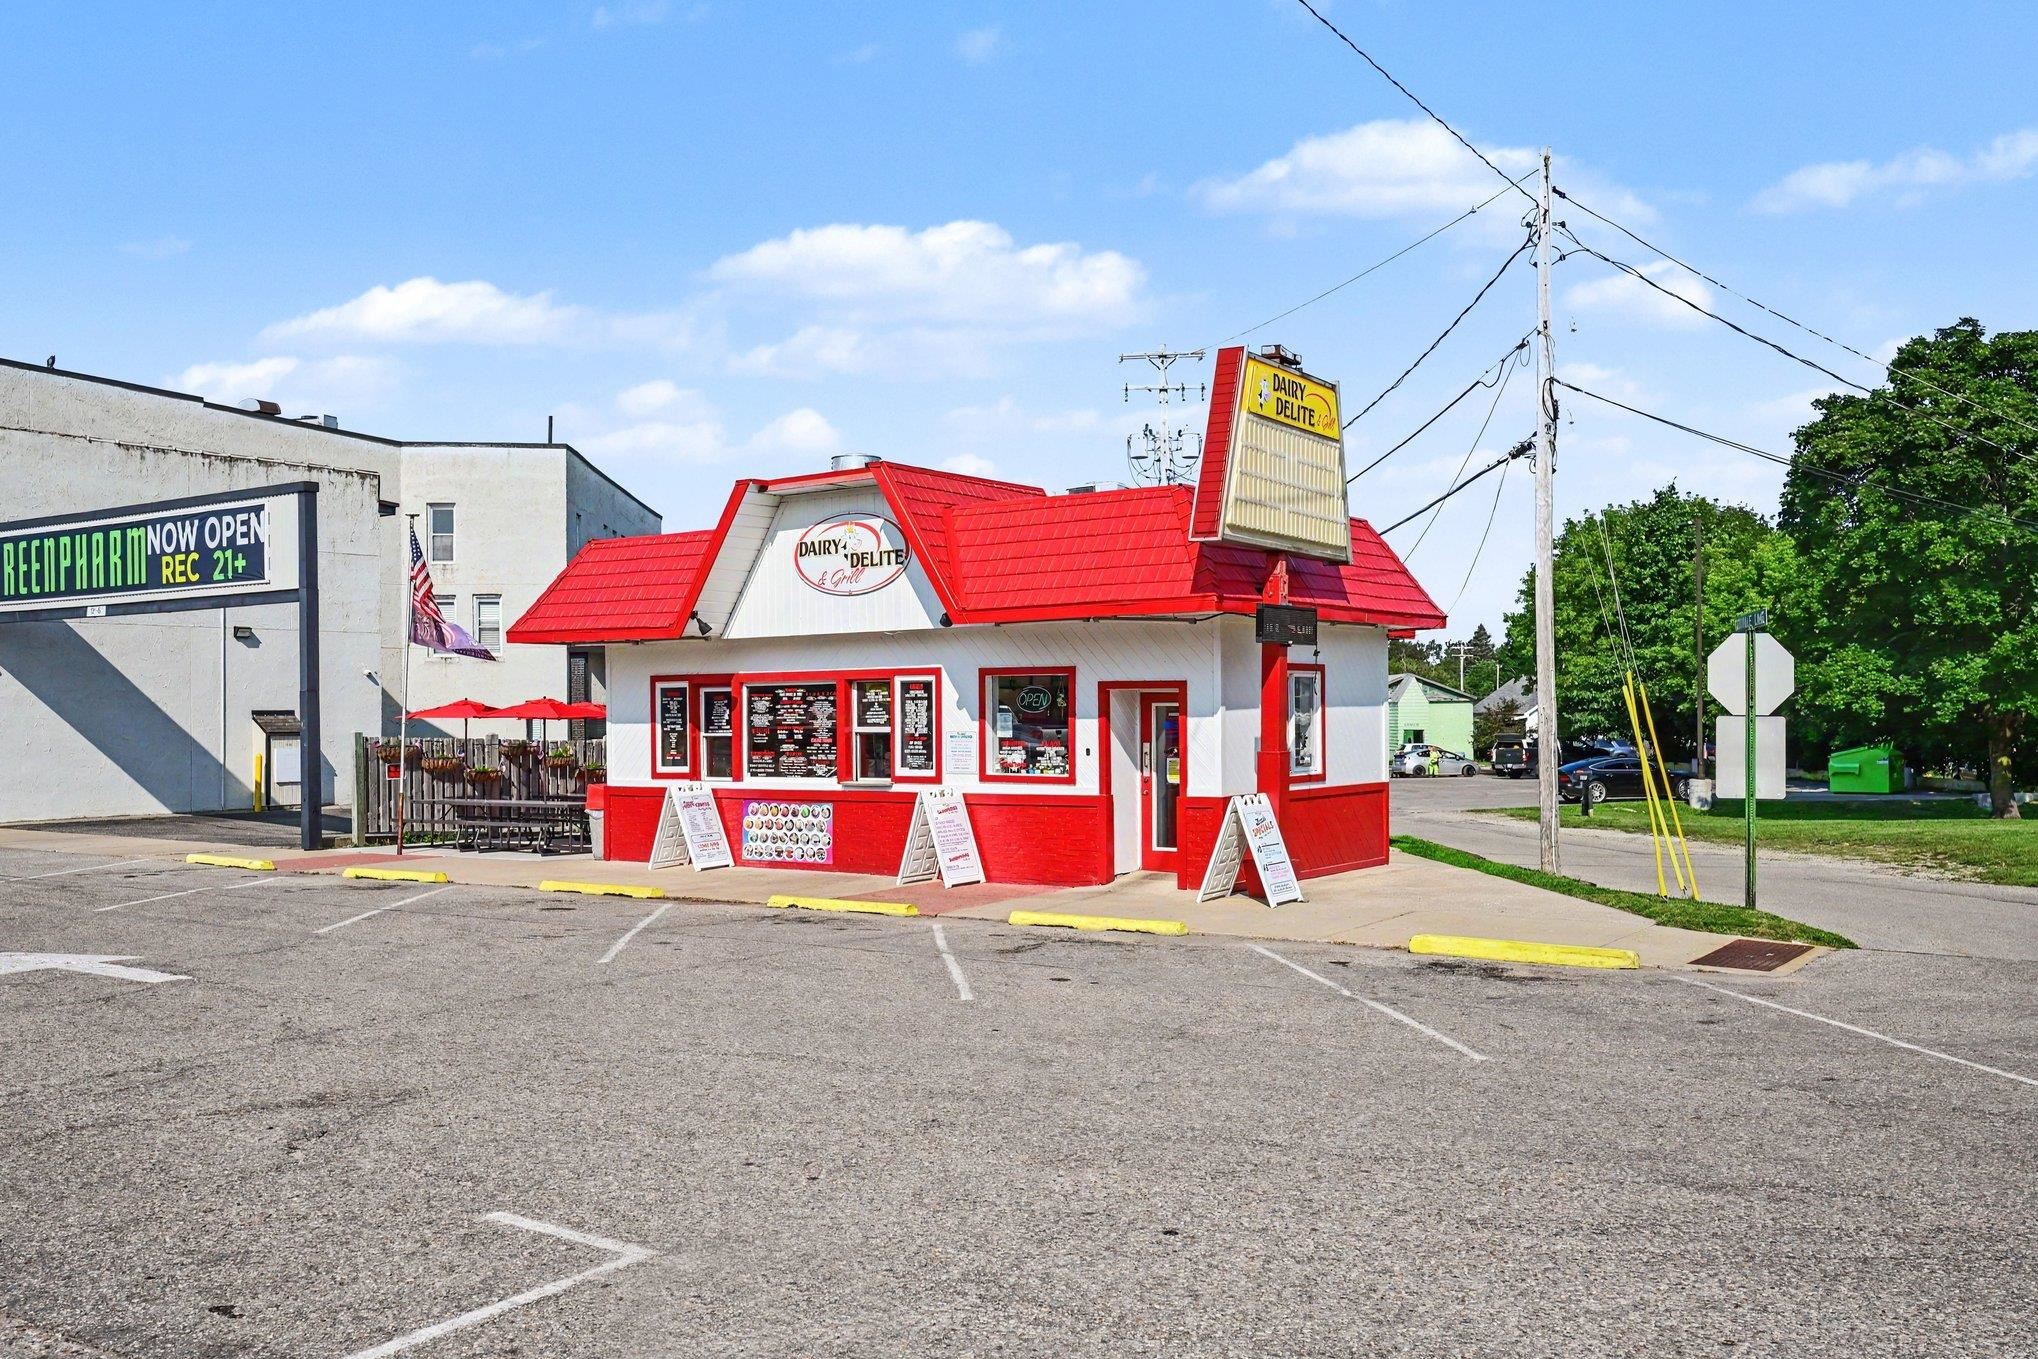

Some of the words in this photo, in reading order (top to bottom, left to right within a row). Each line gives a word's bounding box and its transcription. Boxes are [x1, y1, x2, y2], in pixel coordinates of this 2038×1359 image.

[1273, 374, 1306, 401] DAIRY
[1276, 397, 1315, 427] DELITE
[1316, 414, 1322, 426] &
[147, 519, 199, 555] NOW
[204, 510, 265, 549] OPEN
[799, 539, 841, 557] DAIRY
[850, 548, 905, 569] DELITE
[161, 551, 200, 585] REC
[212, 549, 247, 581] 21+
[818, 570, 828, 586] &
[830, 567, 866, 589] Grill
[1020, 693, 1047, 706] OPEN
